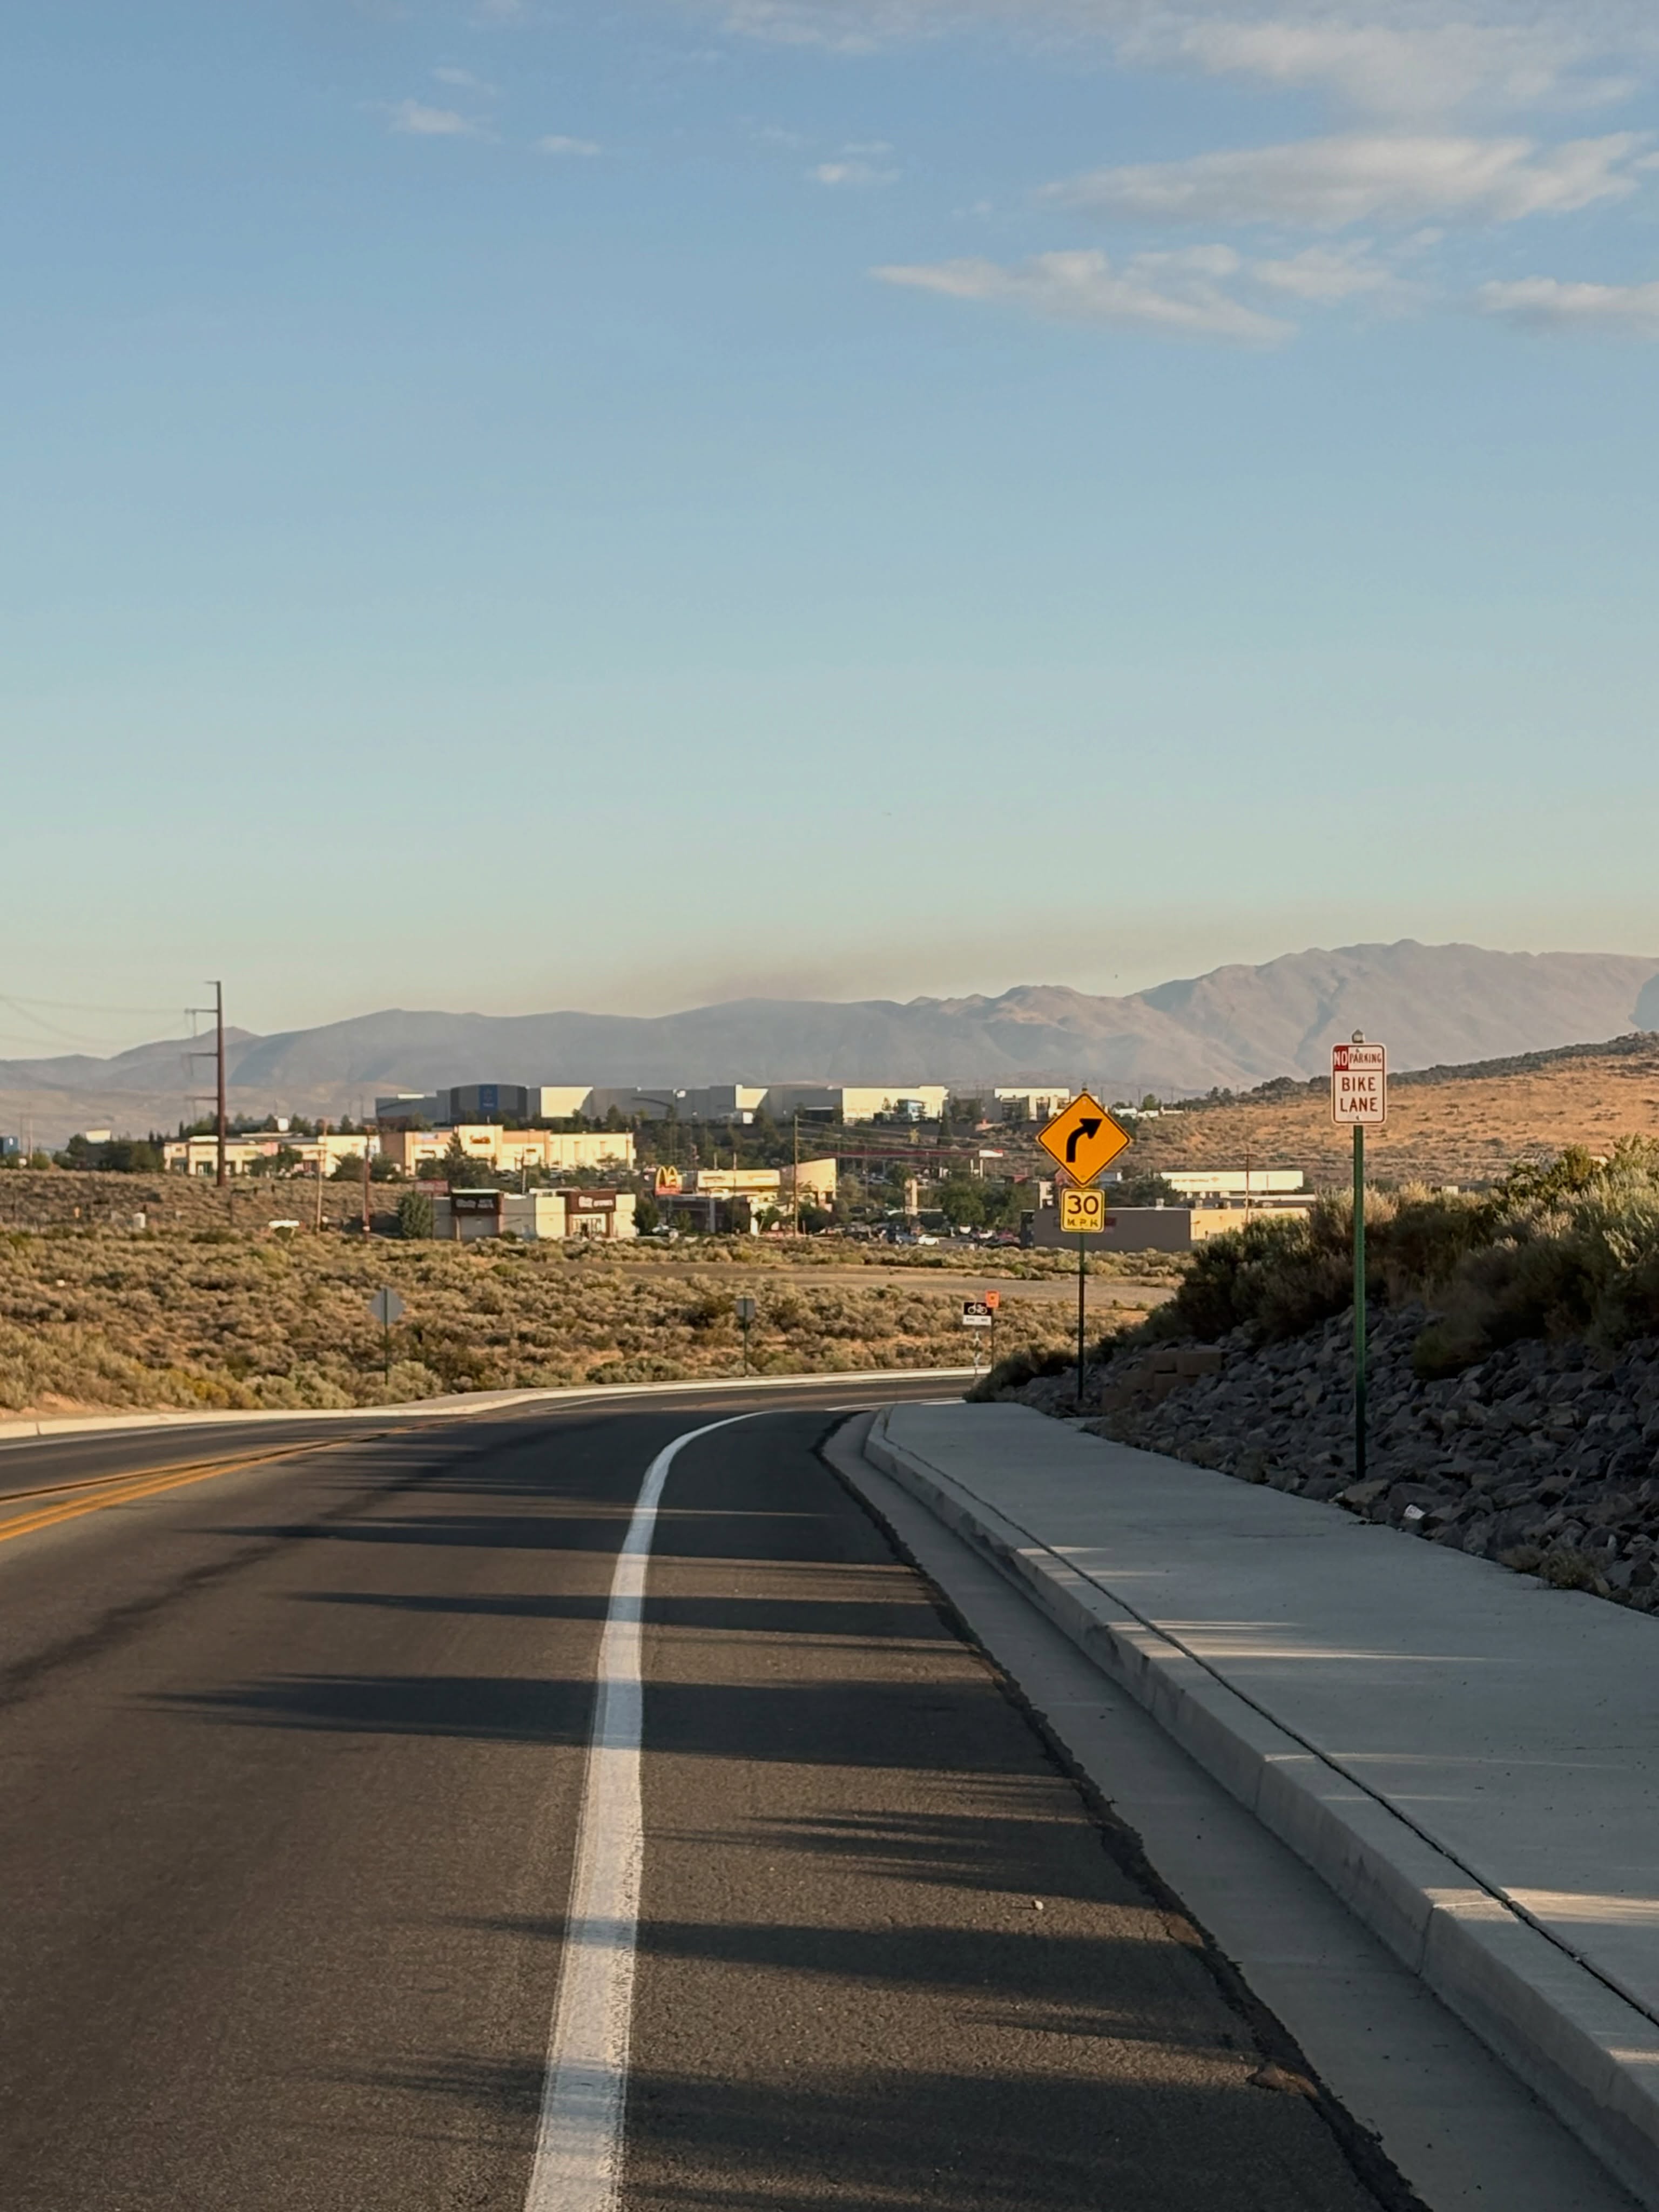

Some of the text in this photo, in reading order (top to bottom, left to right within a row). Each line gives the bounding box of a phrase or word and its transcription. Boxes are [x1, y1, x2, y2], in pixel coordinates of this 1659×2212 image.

[1334, 1051, 1381, 1066] NO PARKING
[1341, 1076, 1376, 1091] BIKE
[1340, 1097, 1378, 1112] LANE
[1067, 1195, 1098, 1215] 30
